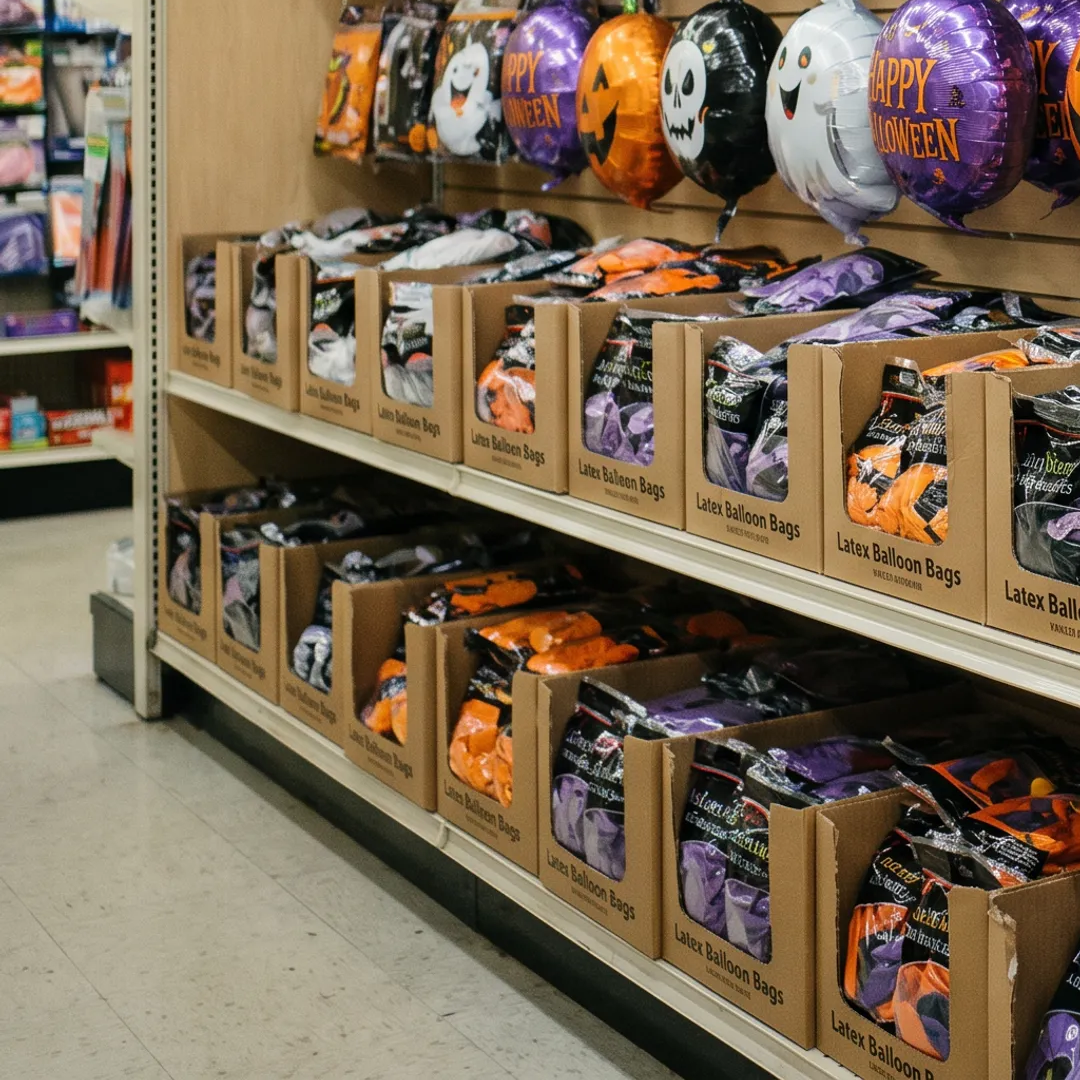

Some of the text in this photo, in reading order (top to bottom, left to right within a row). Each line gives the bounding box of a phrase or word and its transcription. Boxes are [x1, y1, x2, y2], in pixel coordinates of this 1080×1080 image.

[639, 475, 666, 502] Bags
[695, 492, 724, 517] Latex
[725, 500, 767, 529] Balloon
[769, 512, 801, 541] Bags
[836, 531, 871, 560] Latex
[872, 542, 922, 575] Balloon
[925, 558, 962, 589] Bags
[1004, 579, 1046, 612] Latex
[705, 940, 750, 985] Balloon
[752, 970, 784, 1006] Bags
[831, 1009, 866, 1051] Latex
[868, 1034, 921, 1080] Balloon
